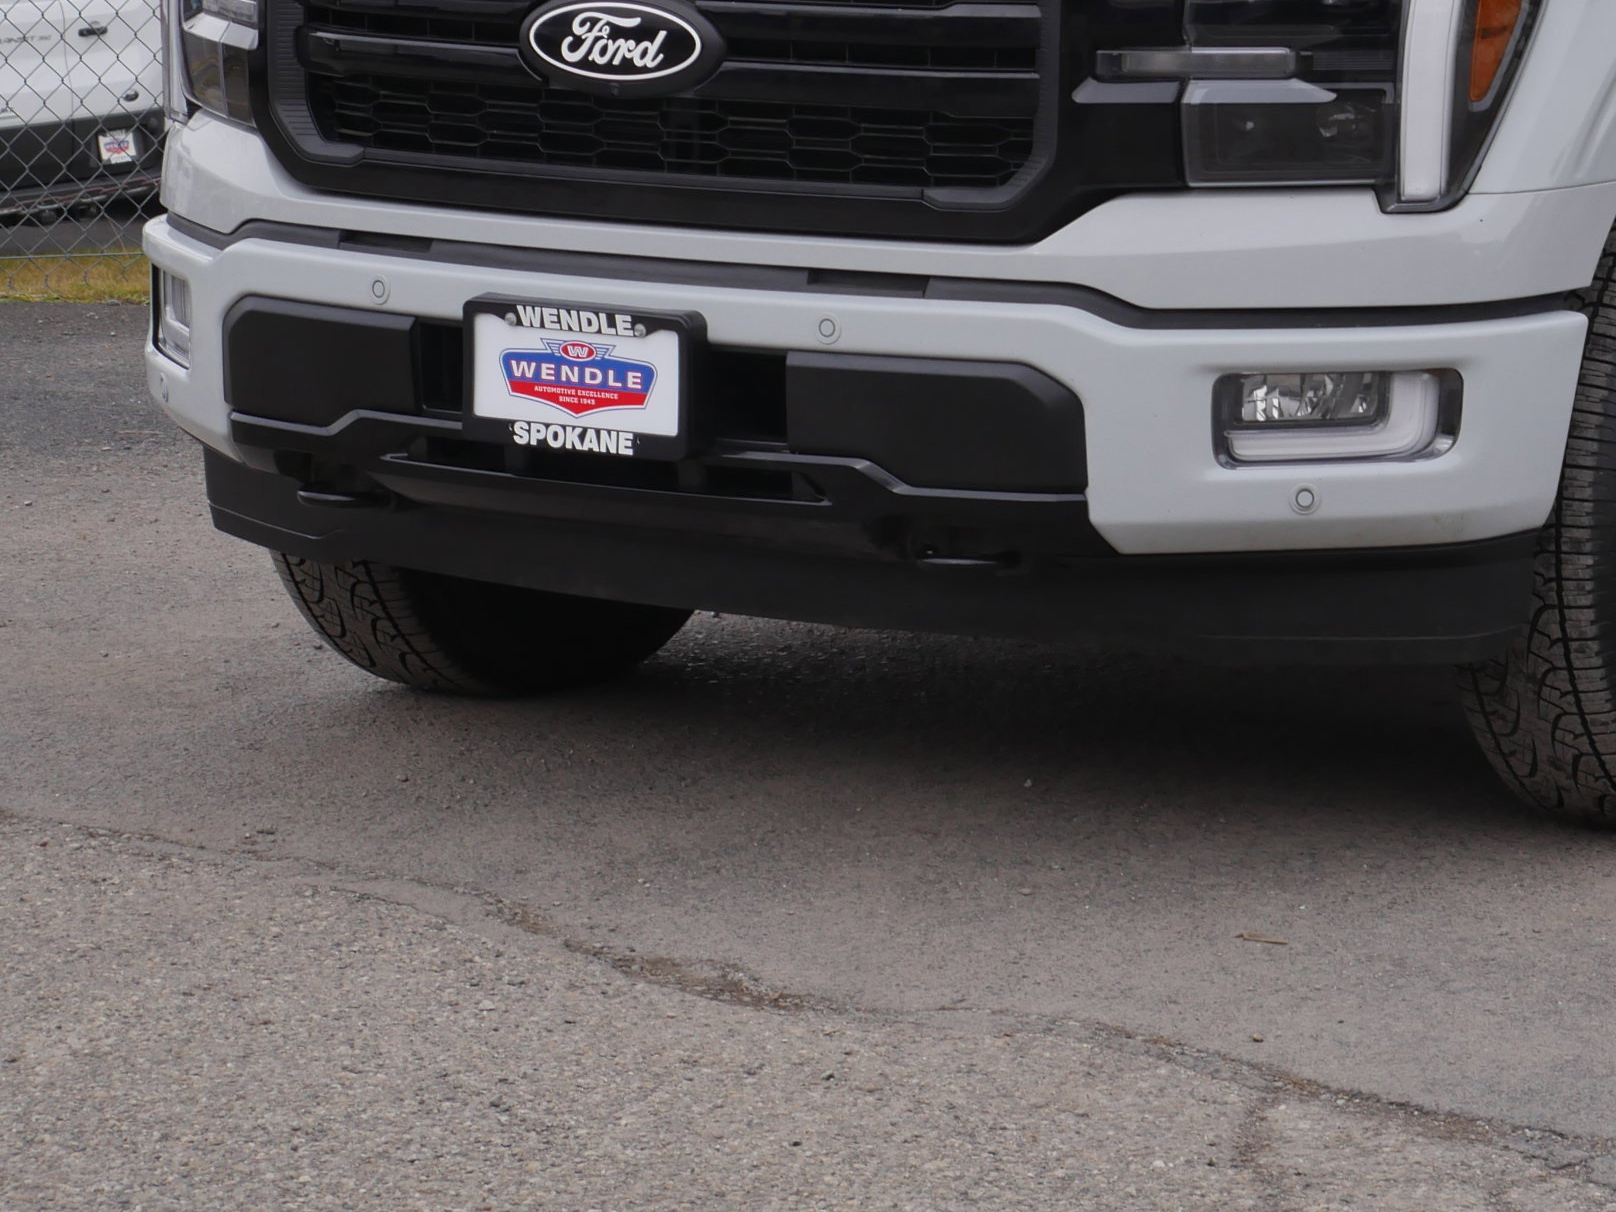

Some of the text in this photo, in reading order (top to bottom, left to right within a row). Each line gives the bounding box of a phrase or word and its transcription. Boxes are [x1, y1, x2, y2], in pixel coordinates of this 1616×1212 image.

[561, 11, 667, 69] Ford
[516, 305, 634, 337] WENDLE
[511, 360, 642, 389] WENDLE
[534, 385, 619, 400] AUTOMOTIVE EXCELLENCE
[558, 396, 596, 406] SINCE 1943
[513, 420, 634, 456] SPOKANE
